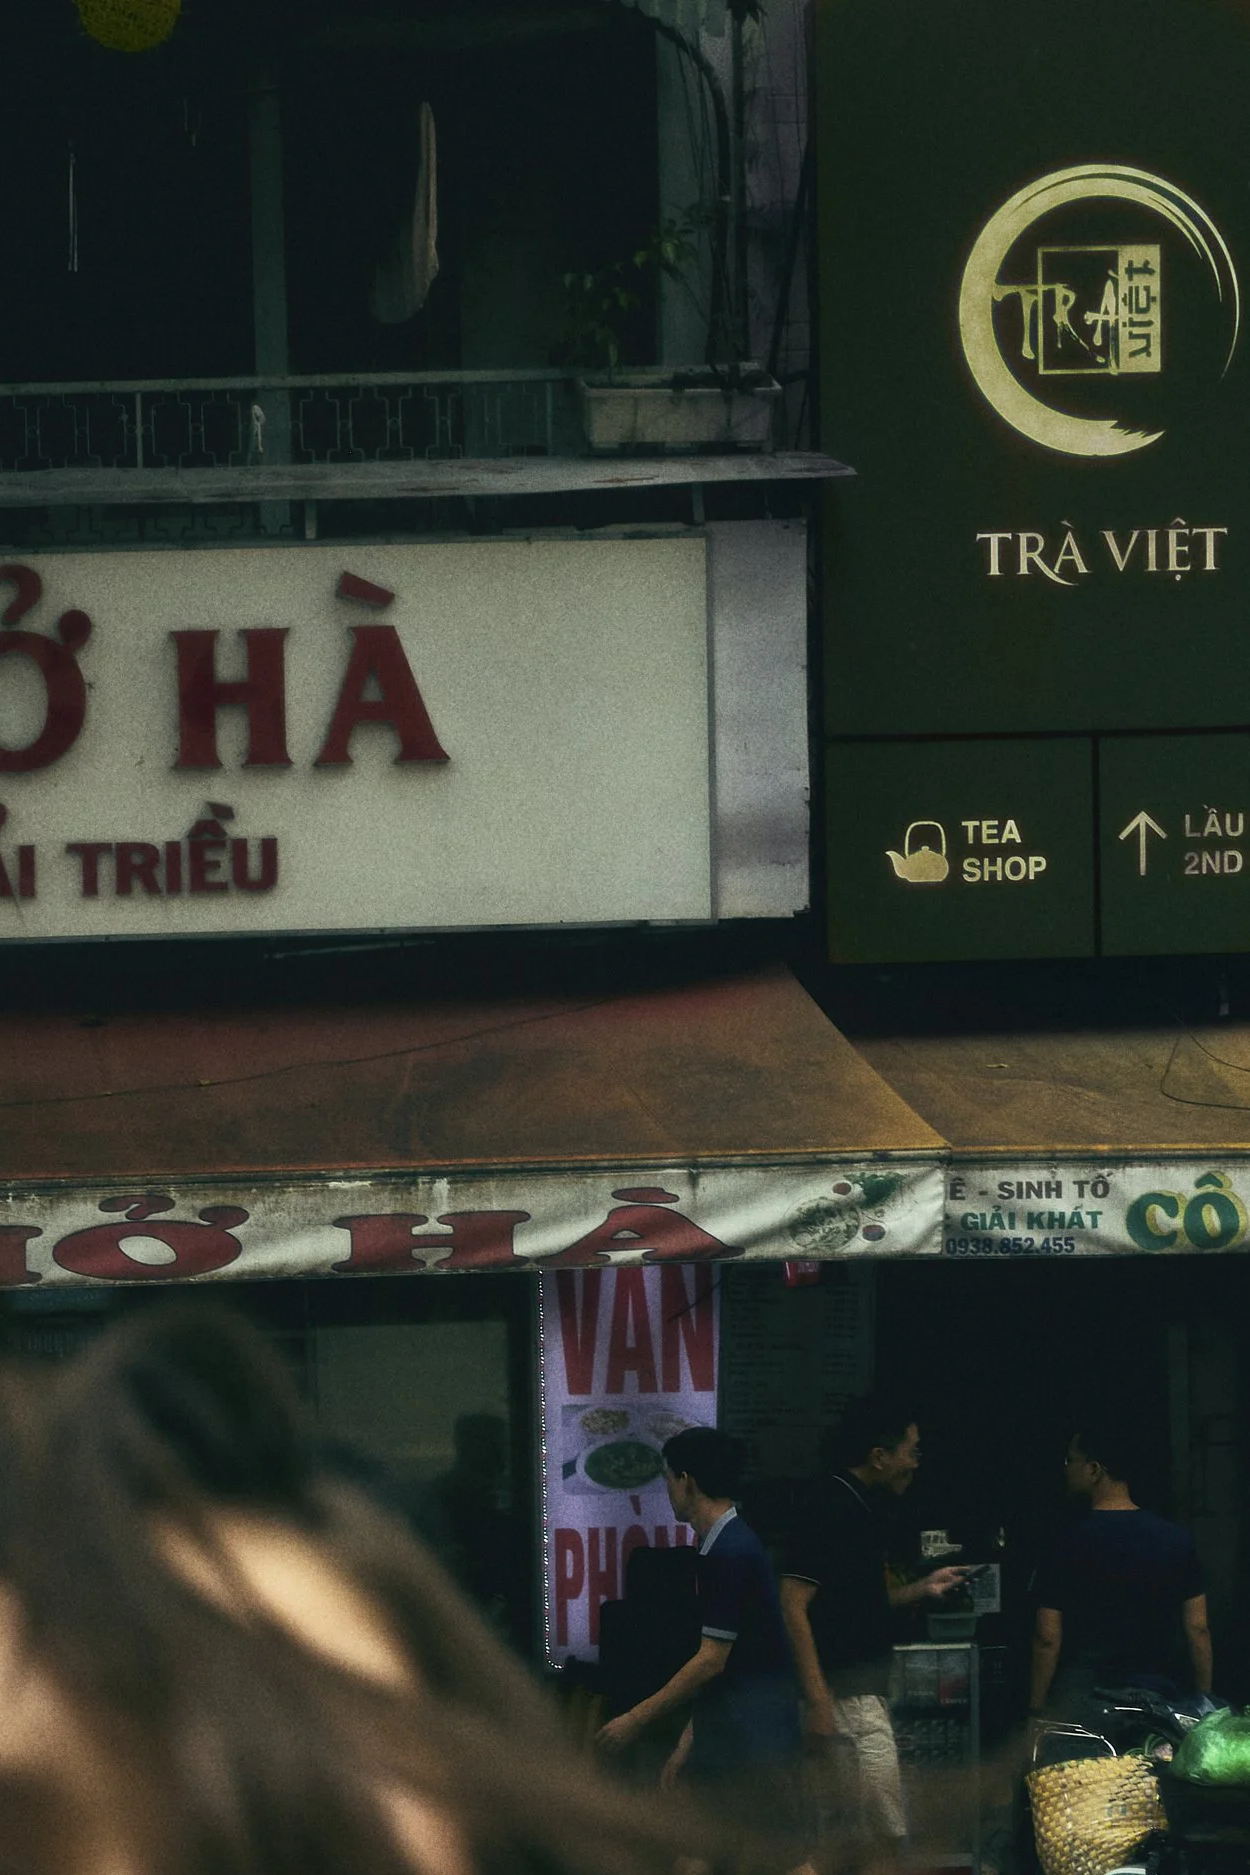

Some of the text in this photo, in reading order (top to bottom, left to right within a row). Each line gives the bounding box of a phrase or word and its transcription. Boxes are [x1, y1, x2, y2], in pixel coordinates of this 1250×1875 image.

[976, 517, 1228, 586] TRÀ VIỆT
[171, 571, 449, 768] HÀ
[961, 820, 1021, 845] TEA
[1185, 805, 1244, 839] LẦU
[66, 801, 279, 898] TRIỀU
[1184, 850, 1244, 875] 2ND
[962, 856, 1047, 882] SHOP
[998, 1180, 1062, 1200] SINH
[1073, 1172, 1111, 1199] TỐ
[960, 1205, 1016, 1231] GIẢI
[1027, 1204, 1103, 1231] KHÁT
[1126, 1170, 1247, 1252] CÔ
[333, 1186, 744, 1271] HÀ
[946, 1236, 1075, 1256] 0938.852.455
